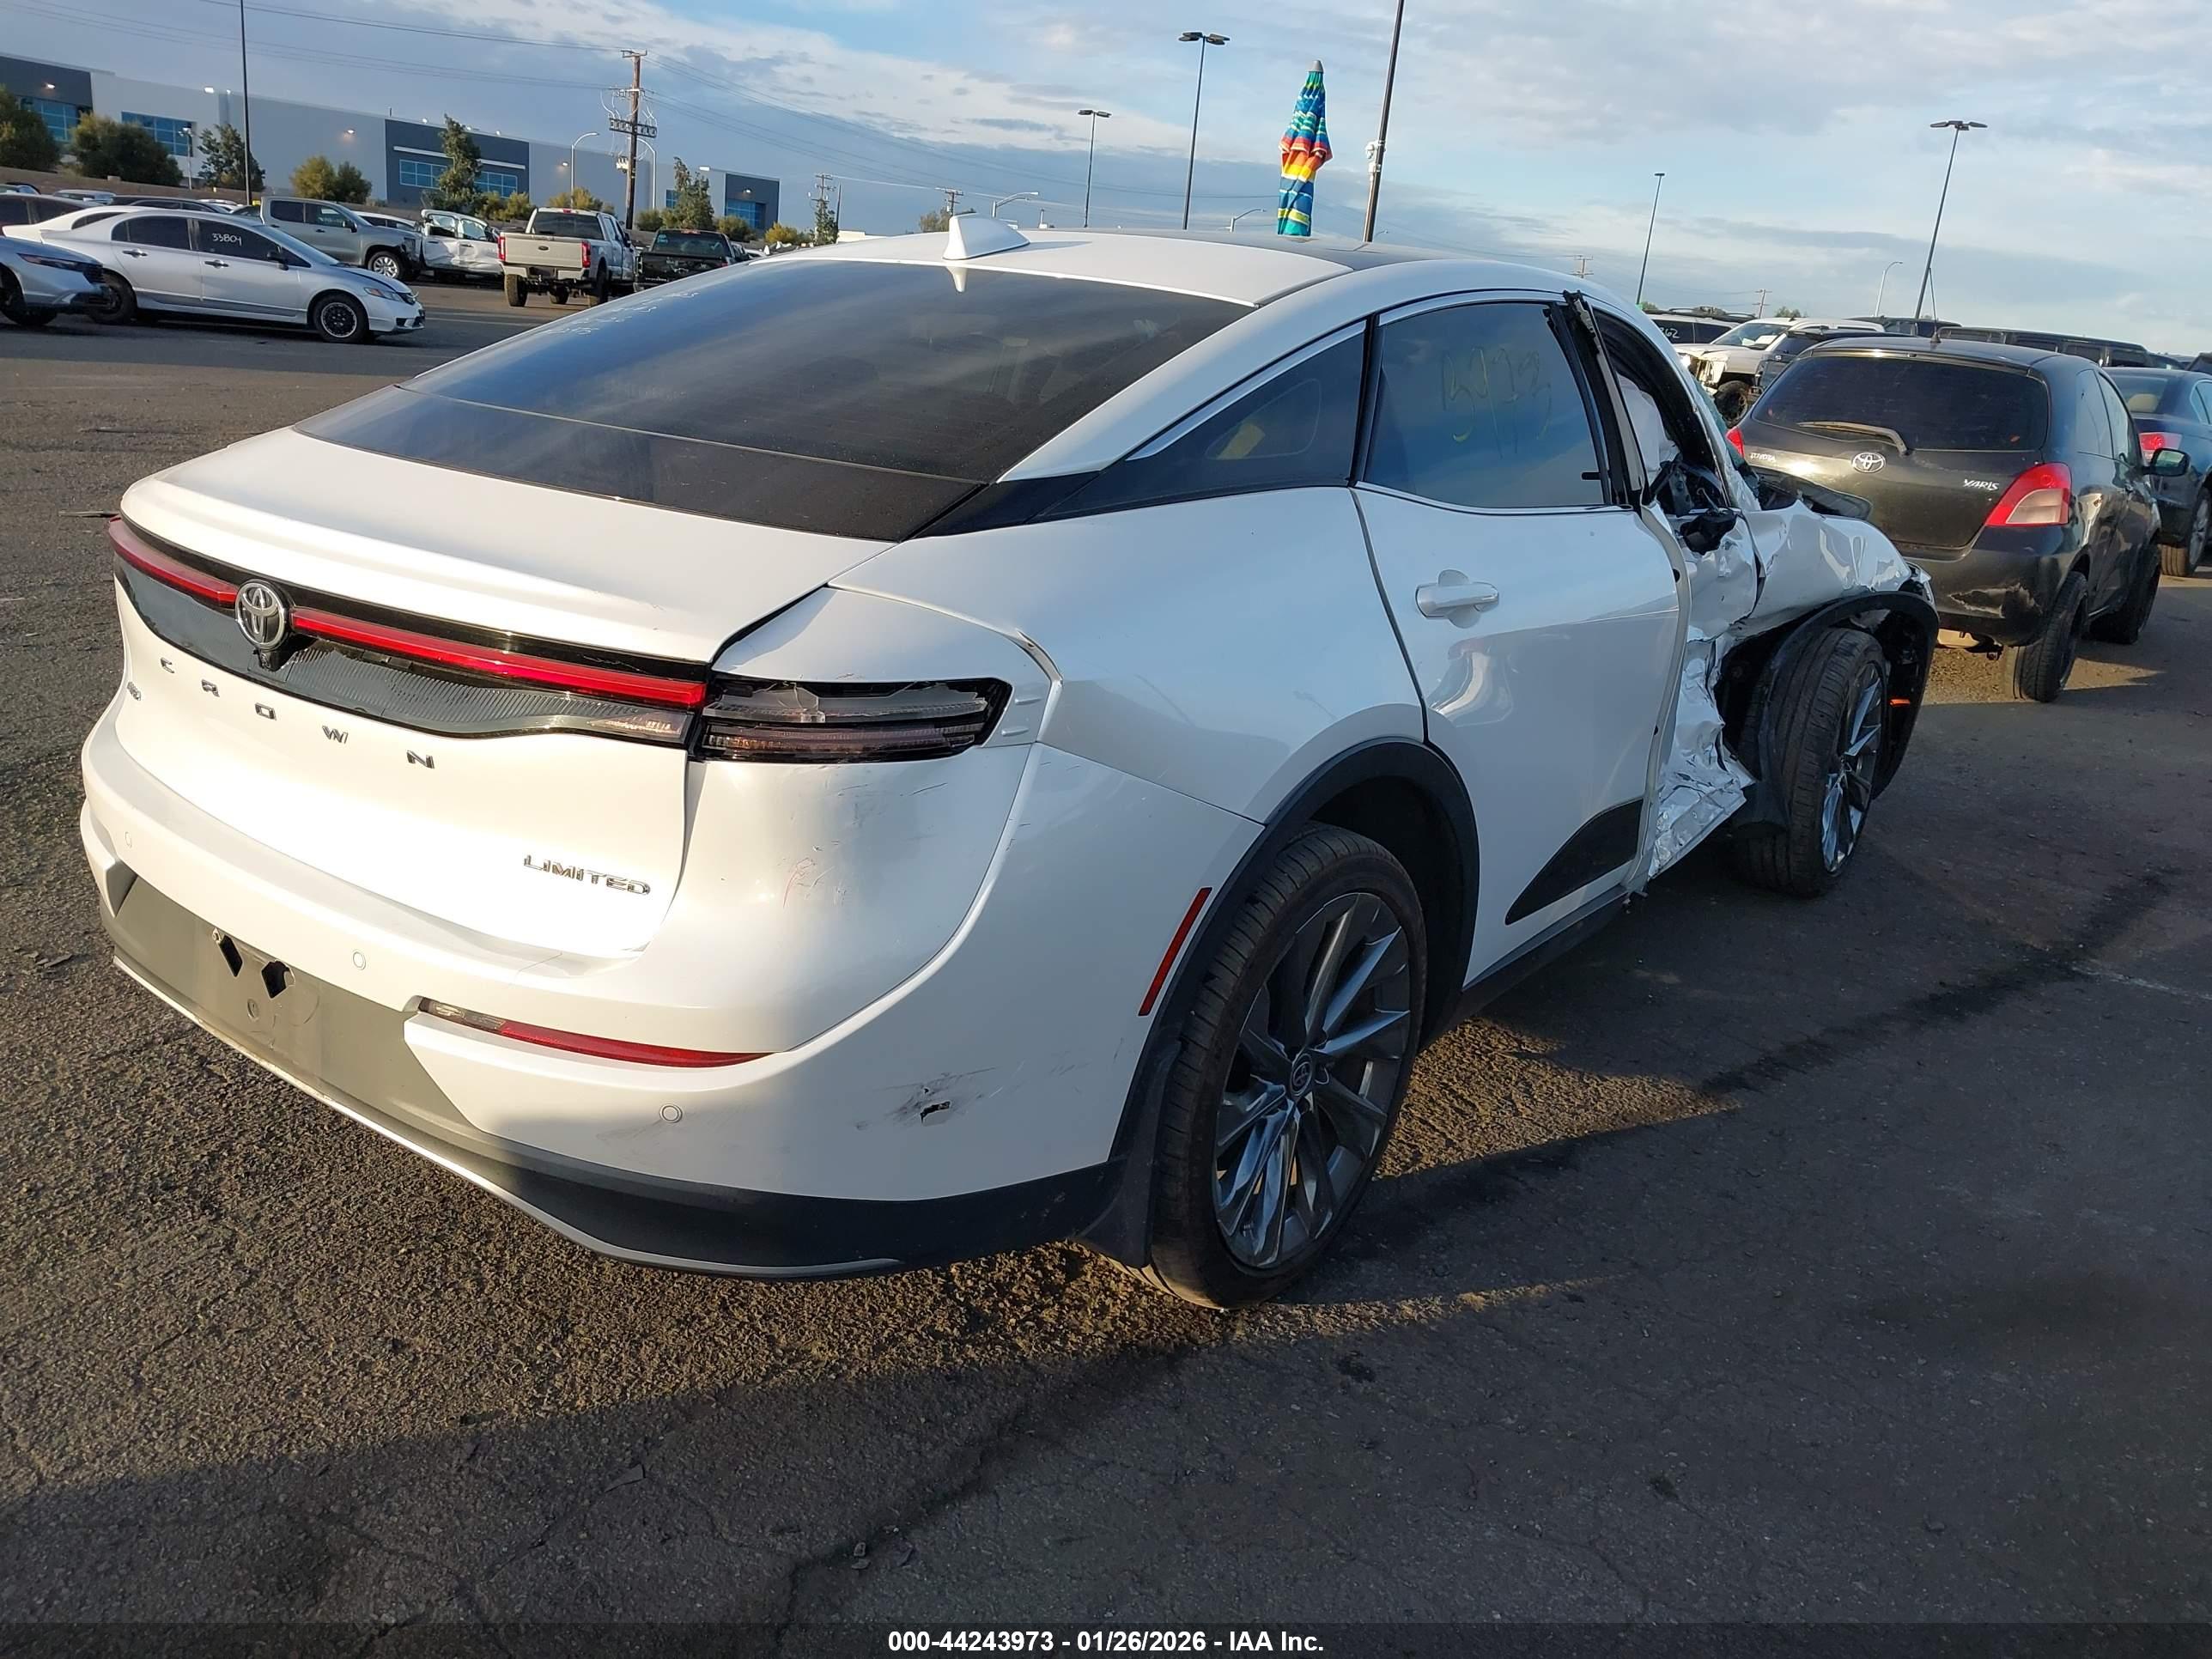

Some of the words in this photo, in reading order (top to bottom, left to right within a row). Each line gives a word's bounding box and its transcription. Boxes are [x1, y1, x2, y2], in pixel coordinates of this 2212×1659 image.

[1963, 478, 2000, 491] YARIS
[160, 656, 435, 769] CROWN
[523, 854, 651, 896] LIMITED
